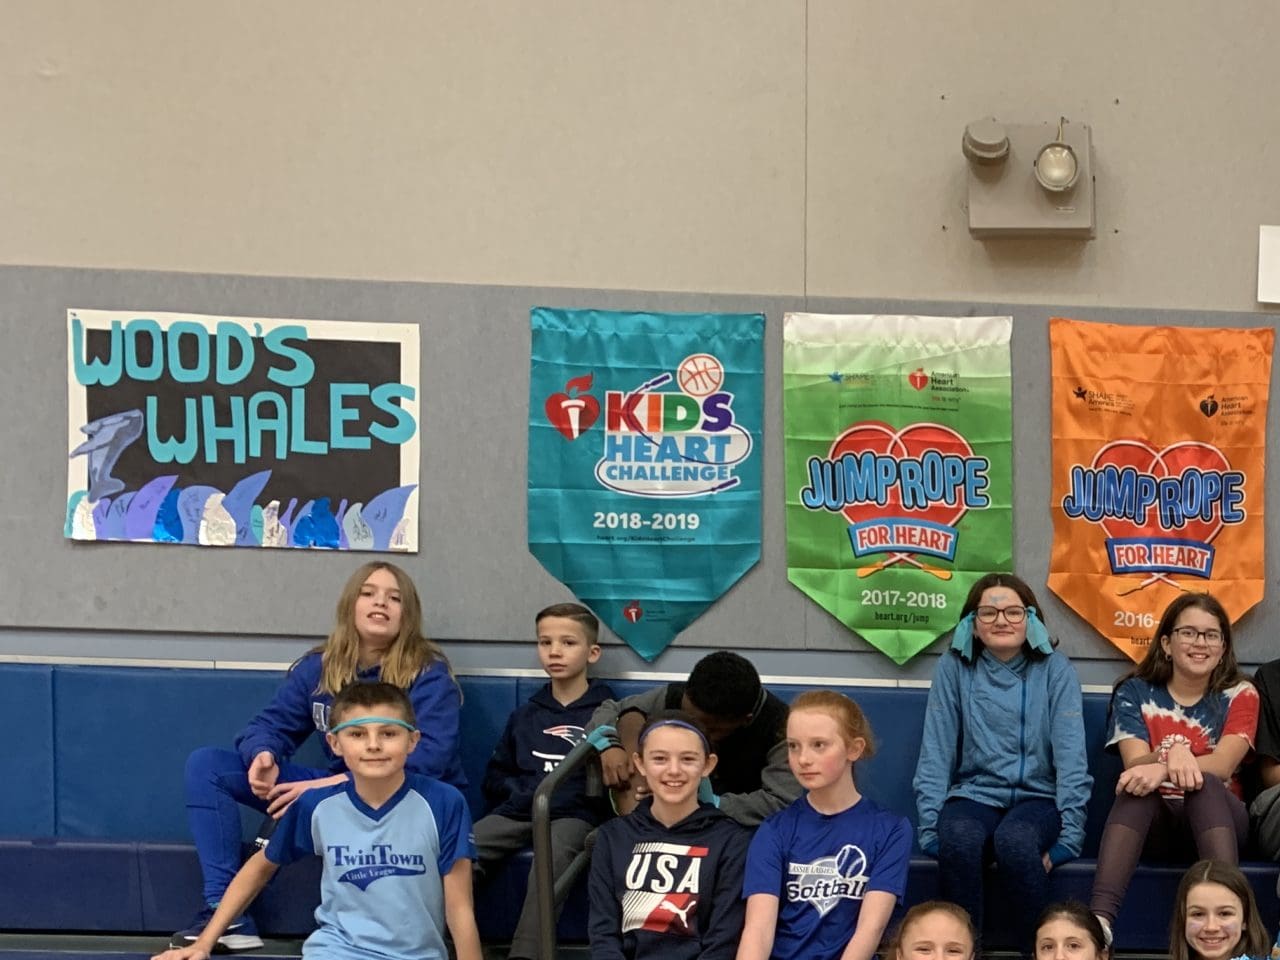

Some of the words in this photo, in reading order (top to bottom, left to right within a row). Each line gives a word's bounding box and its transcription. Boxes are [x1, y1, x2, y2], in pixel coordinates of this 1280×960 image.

[72, 319, 315, 387] WOOD'S
[930, 378, 954, 386] Heart
[147, 383, 417, 464] WHALES
[607, 392, 733, 433] KIDS
[607, 435, 731, 464] HEART
[606, 465, 728, 481] CHALLENGE
[801, 450, 898, 511] JUMP
[898, 449, 991, 511] ROPE
[1063, 464, 1156, 526] JUMP
[1157, 467, 1246, 528] ROPE
[593, 511, 700, 530] 2018-2019
[858, 525, 890, 550] FOR
[895, 525, 953, 552] HEART
[1115, 544, 1148, 567] FOR
[1151, 544, 1210, 570] HEART
[861, 590, 947, 609] 2017-2018
[874, 611, 930, 624] heart.org/jump
[1113, 611, 1161, 628] 2016-
[1130, 636, 1151, 648] heart
[626, 853, 702, 893] USA
[787, 879, 867, 900] Softball
